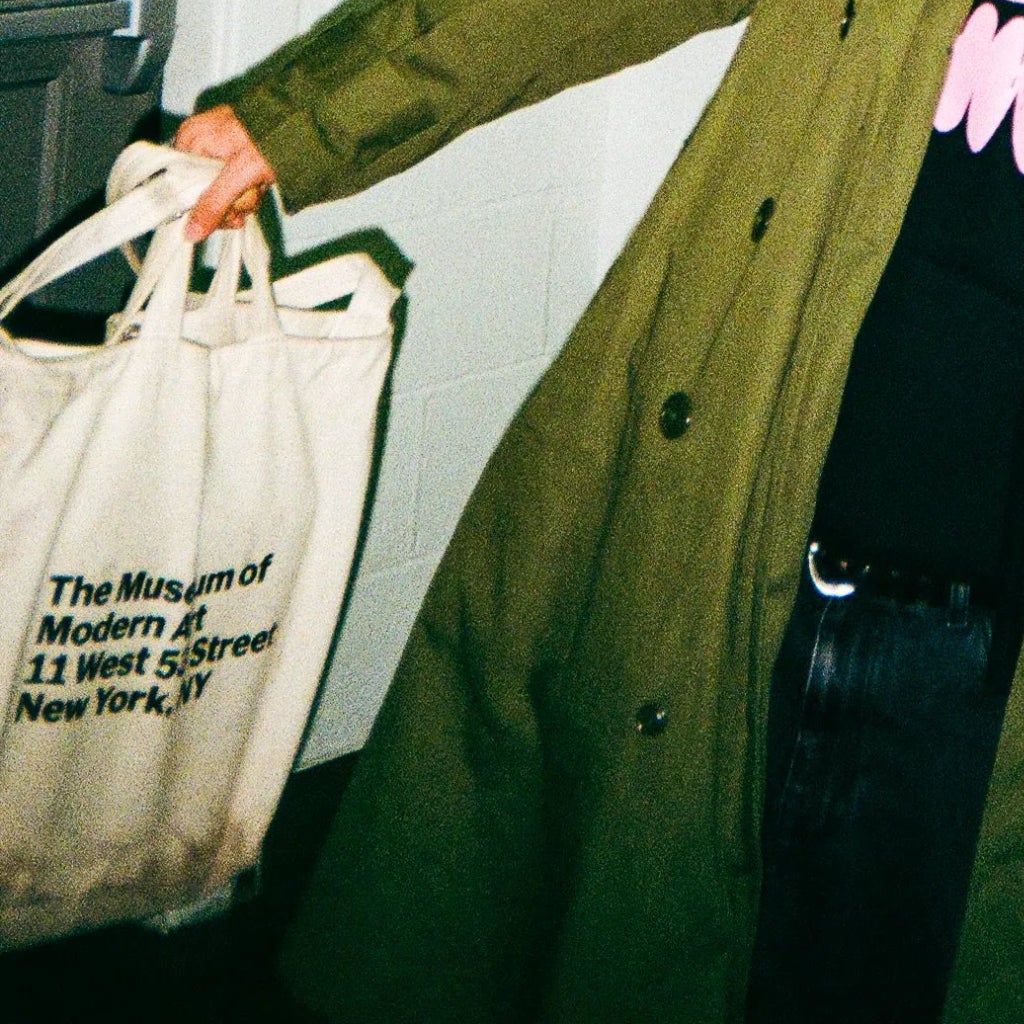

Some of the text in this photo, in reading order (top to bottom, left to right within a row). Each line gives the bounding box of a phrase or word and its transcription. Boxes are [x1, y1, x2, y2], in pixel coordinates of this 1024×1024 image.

[50, 575, 112, 607] The
[238, 553, 275, 587] of
[36, 611, 166, 647] Modern
[24, 653, 68, 686] 11
[76, 647, 151, 683] West
[15, 691, 90, 723] New
[96, 685, 173, 717] York,
